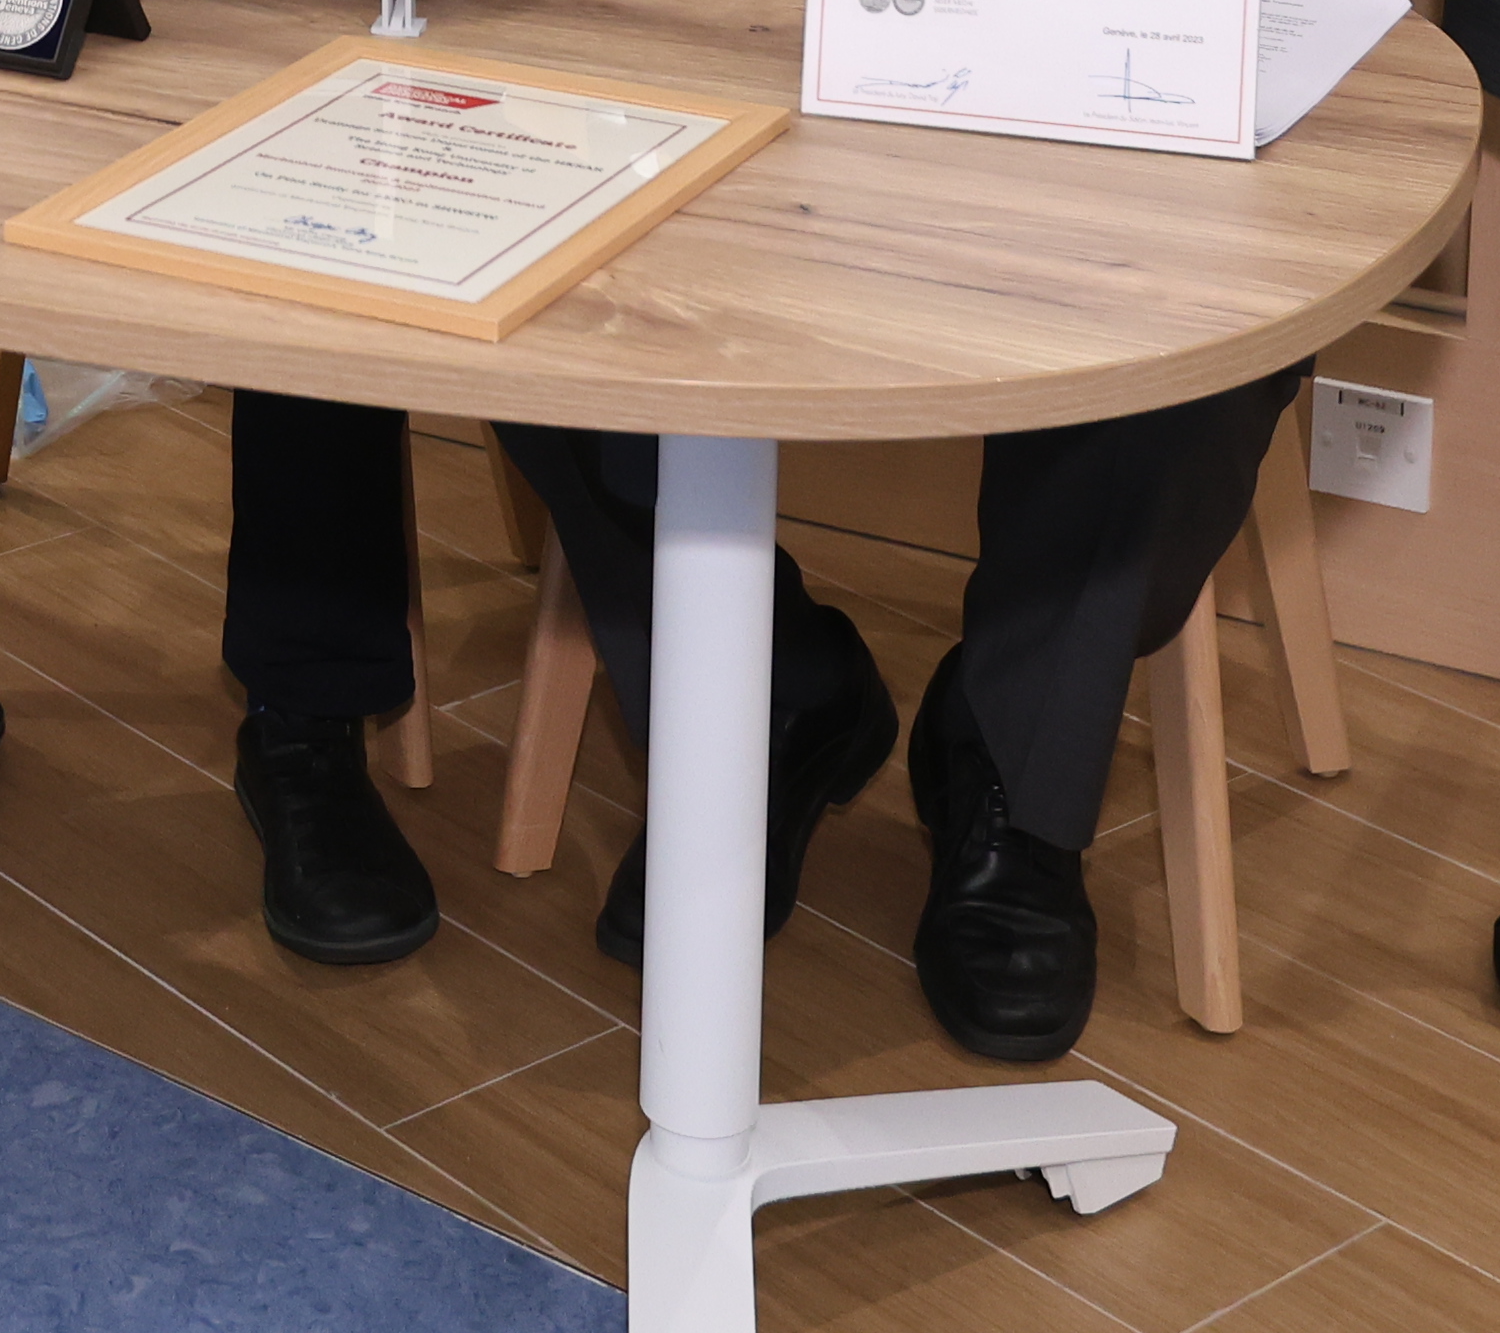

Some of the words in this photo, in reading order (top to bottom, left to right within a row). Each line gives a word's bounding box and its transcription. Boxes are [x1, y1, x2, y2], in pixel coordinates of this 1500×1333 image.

[1150, 30, 1160, 40] 28
[1183, 34, 1204, 44] 2023
[378, 111, 453, 130] Award
[359, 157, 474, 184] Champion
